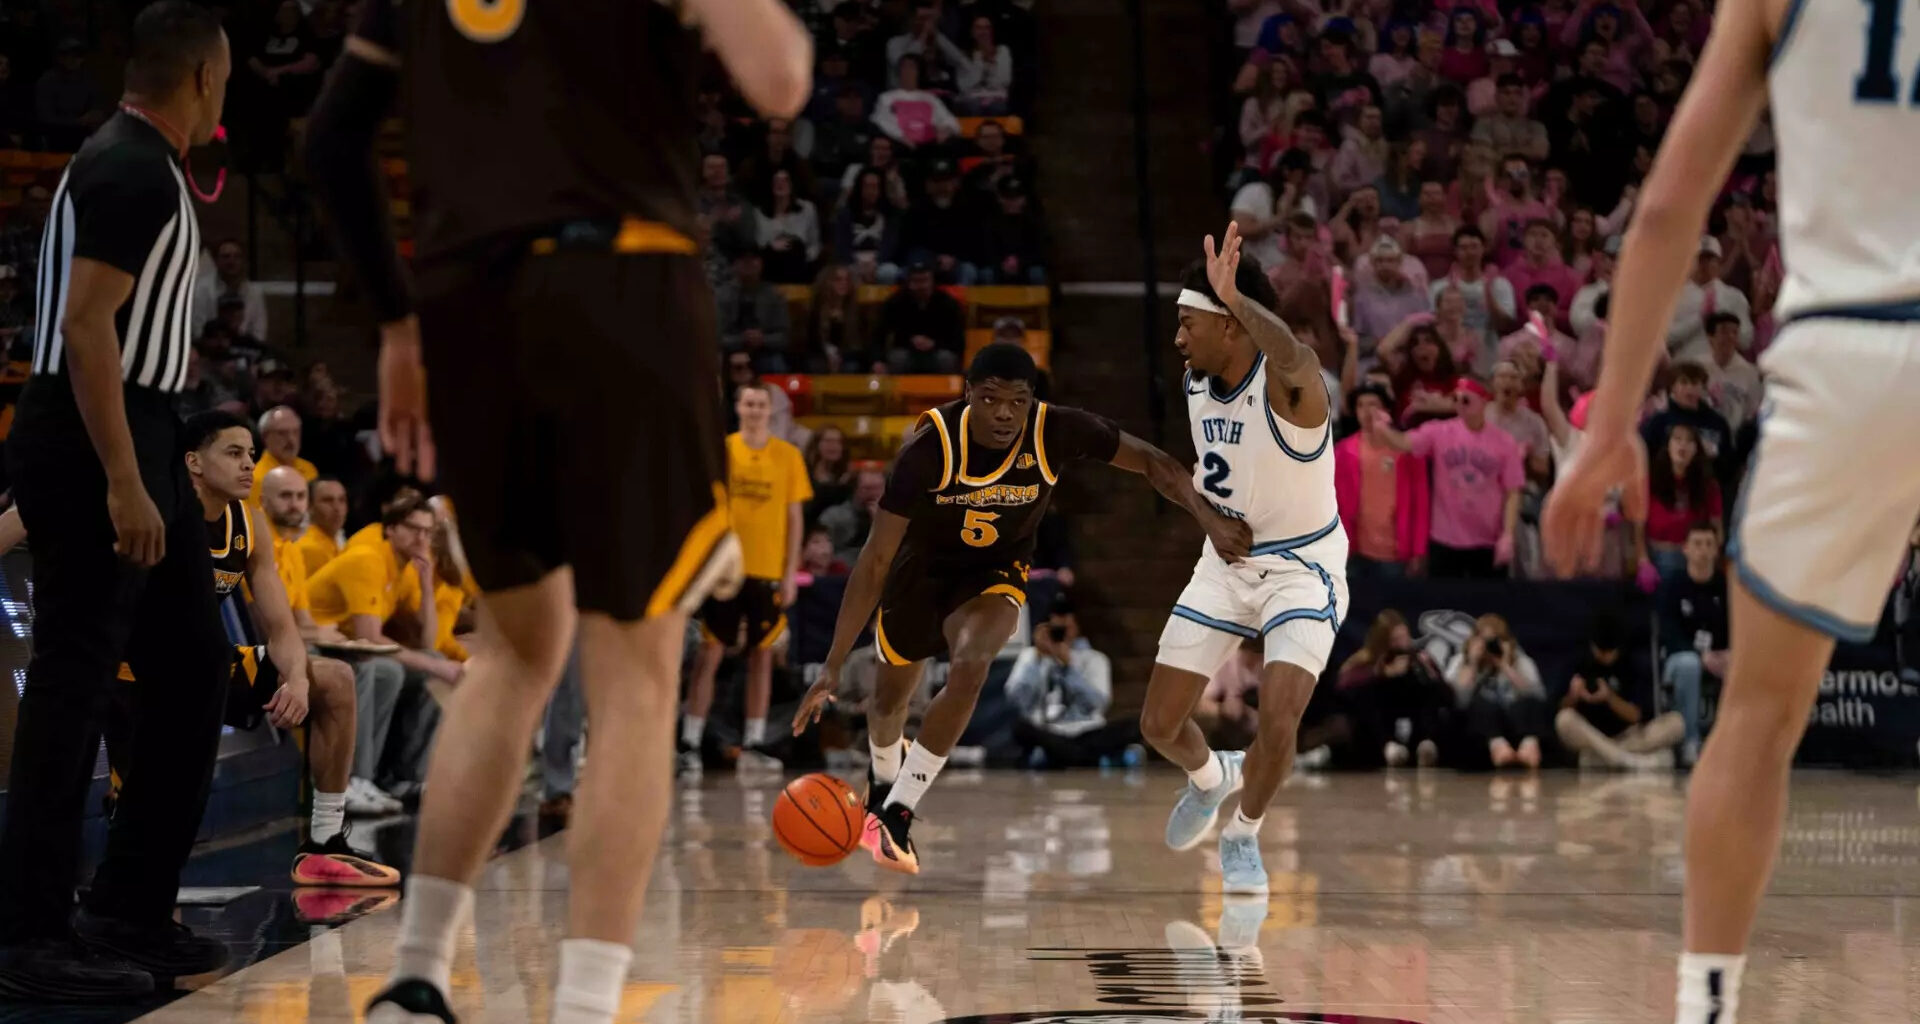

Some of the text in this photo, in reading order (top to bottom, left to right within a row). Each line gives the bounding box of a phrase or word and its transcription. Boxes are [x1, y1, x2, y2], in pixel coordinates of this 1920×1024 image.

[1855, 0, 1920, 104] 1
[1202, 418, 1244, 444] UTH
[1203, 451, 1233, 498] 2
[936, 484, 1039, 507] OMING
[960, 509, 1002, 548] 5
[1810, 697, 1875, 728] alth
